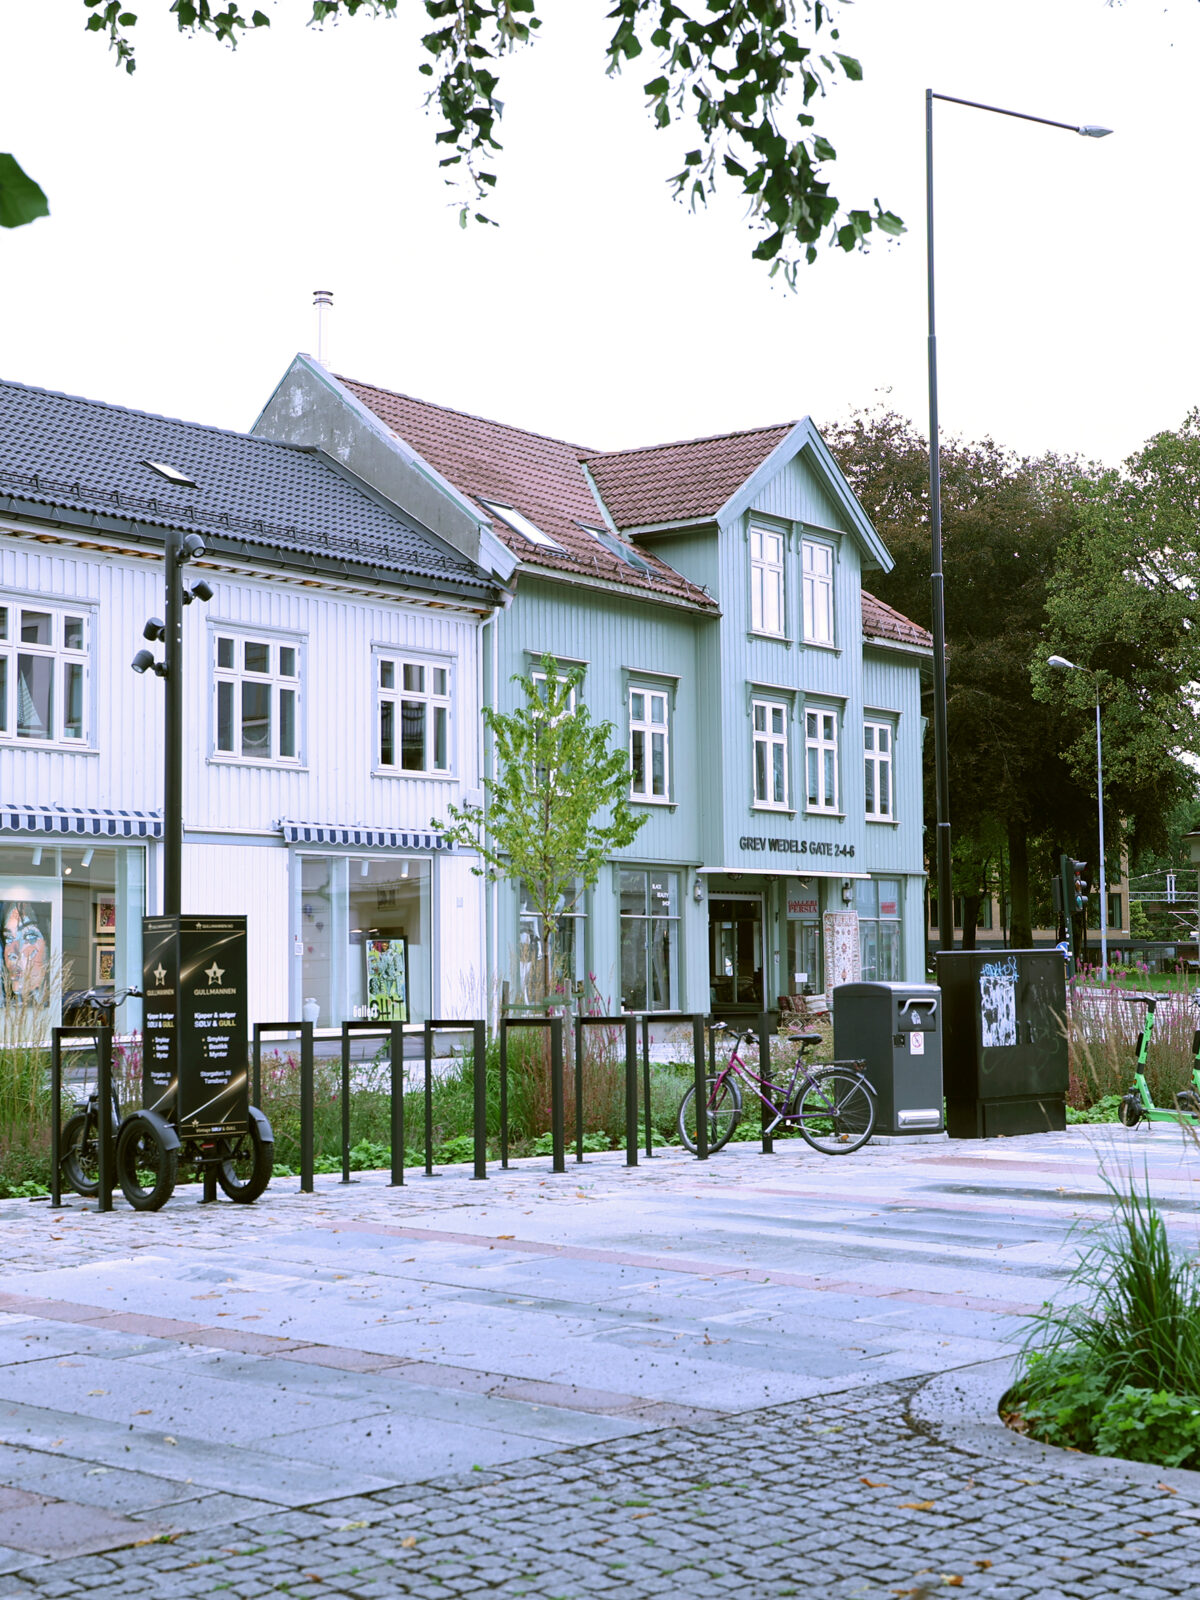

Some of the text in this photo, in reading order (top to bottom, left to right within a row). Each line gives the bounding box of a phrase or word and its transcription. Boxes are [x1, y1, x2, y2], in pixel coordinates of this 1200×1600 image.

[739, 836, 855, 858] GREV WEDELS GATE 2-4-6
[788, 905, 817, 913] PERSIA
[194, 988, 236, 996] GULLMANNEN
[194, 1020, 212, 1028] SØLV
